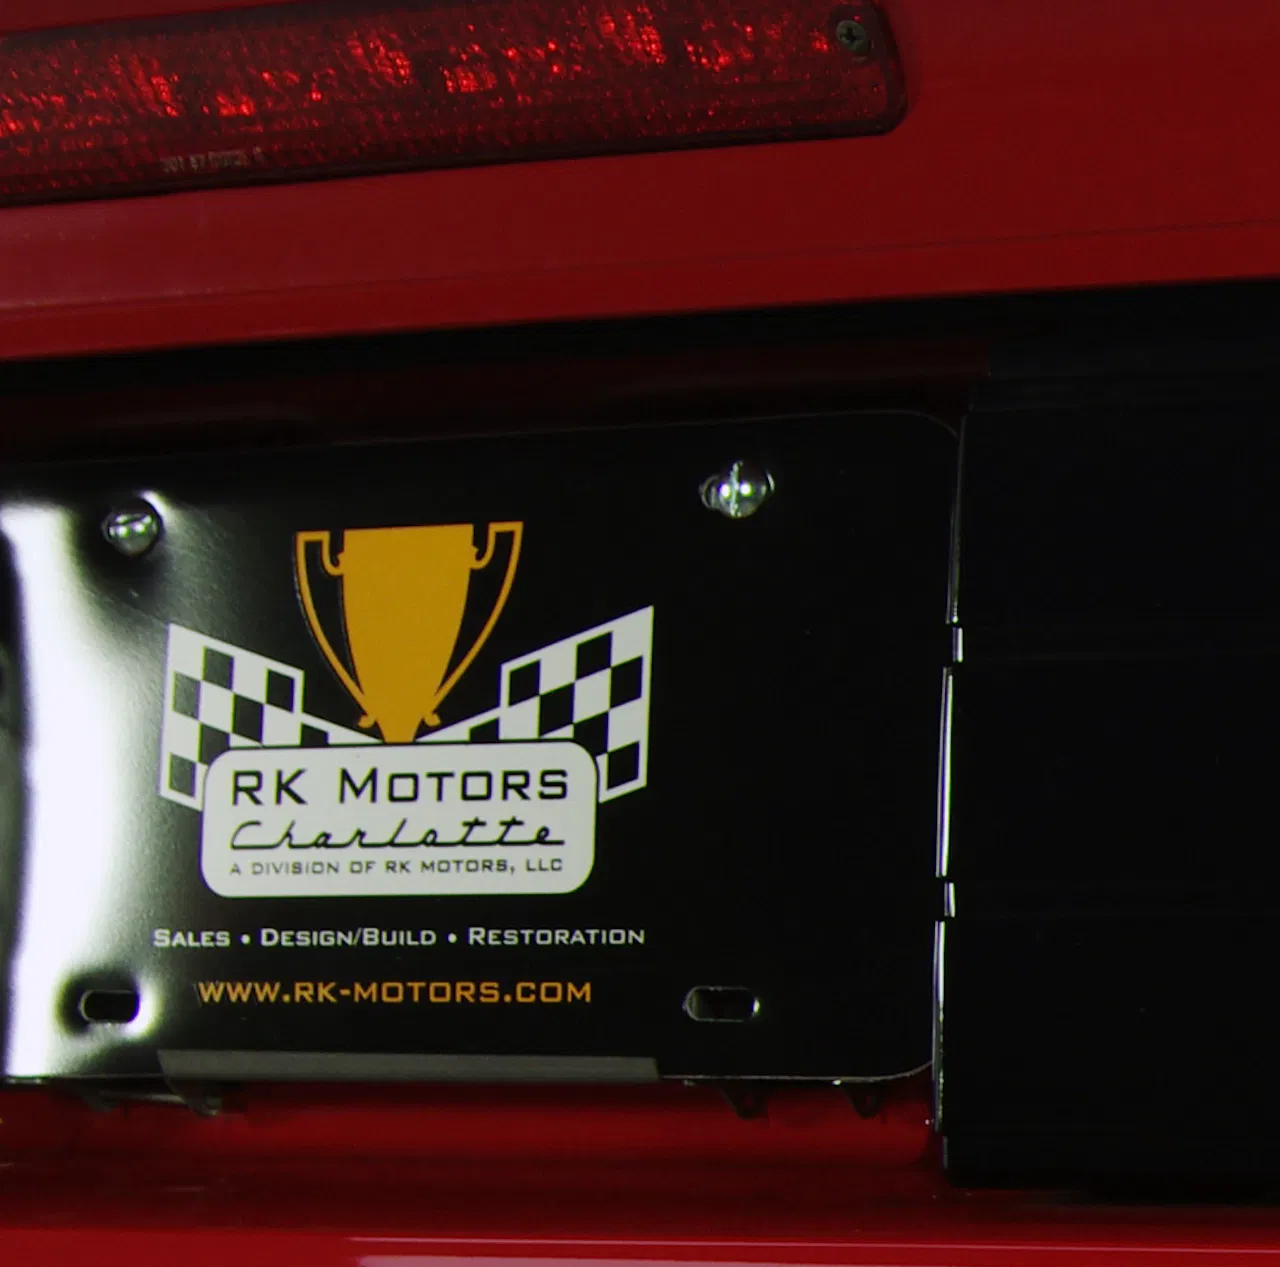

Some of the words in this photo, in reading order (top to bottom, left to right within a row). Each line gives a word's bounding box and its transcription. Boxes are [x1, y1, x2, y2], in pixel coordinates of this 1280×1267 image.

[232, 768, 307, 806] RK
[230, 816, 565, 850] Charlotte
[230, 862, 241, 875] A
[251, 862, 340, 875] DIVISION
[349, 861, 374, 875] OF
[385, 861, 411, 874] RK
[420, 859, 515, 876] MOTORS,
[525, 857, 564, 872] LLC
[198, 981, 592, 1003] WWW.RK-MOTORS.COM
